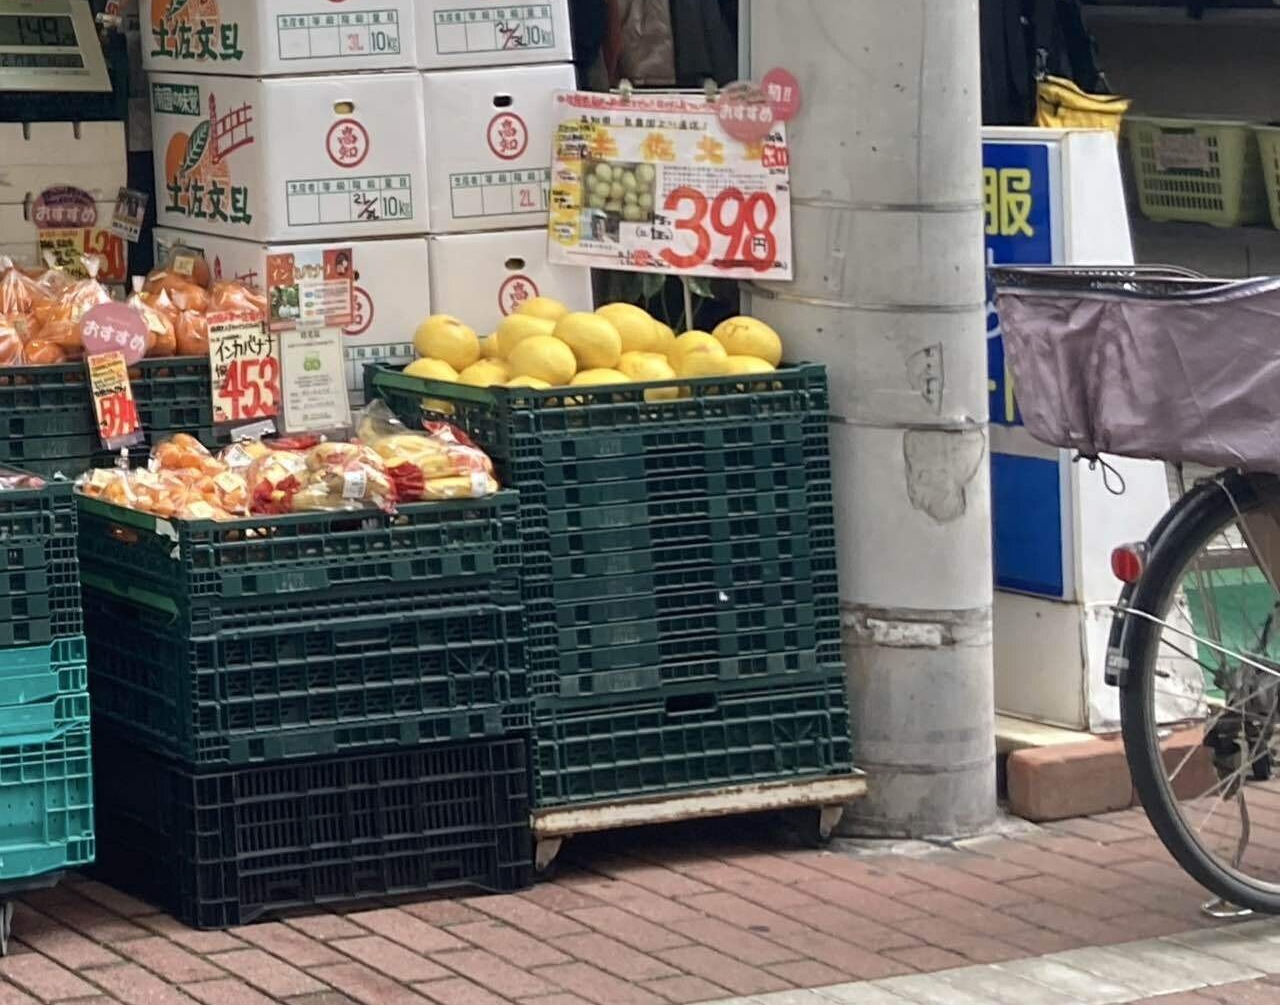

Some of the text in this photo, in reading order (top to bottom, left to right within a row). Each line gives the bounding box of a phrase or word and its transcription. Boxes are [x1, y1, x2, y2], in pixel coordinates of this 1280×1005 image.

[150, 19, 244, 61] 土佐文旦
[337, 126, 358, 160] 高知
[498, 119, 518, 153] 高知
[165, 176, 253, 225] 土佐文旦
[520, 189, 536, 207] 2L
[984, 167, 1034, 237] 服
[659, 184, 777, 272] 398
[83, 318, 146, 352] おすすめ
[216, 335, 276, 362] インカバナナ
[219, 356, 281, 419] 453
